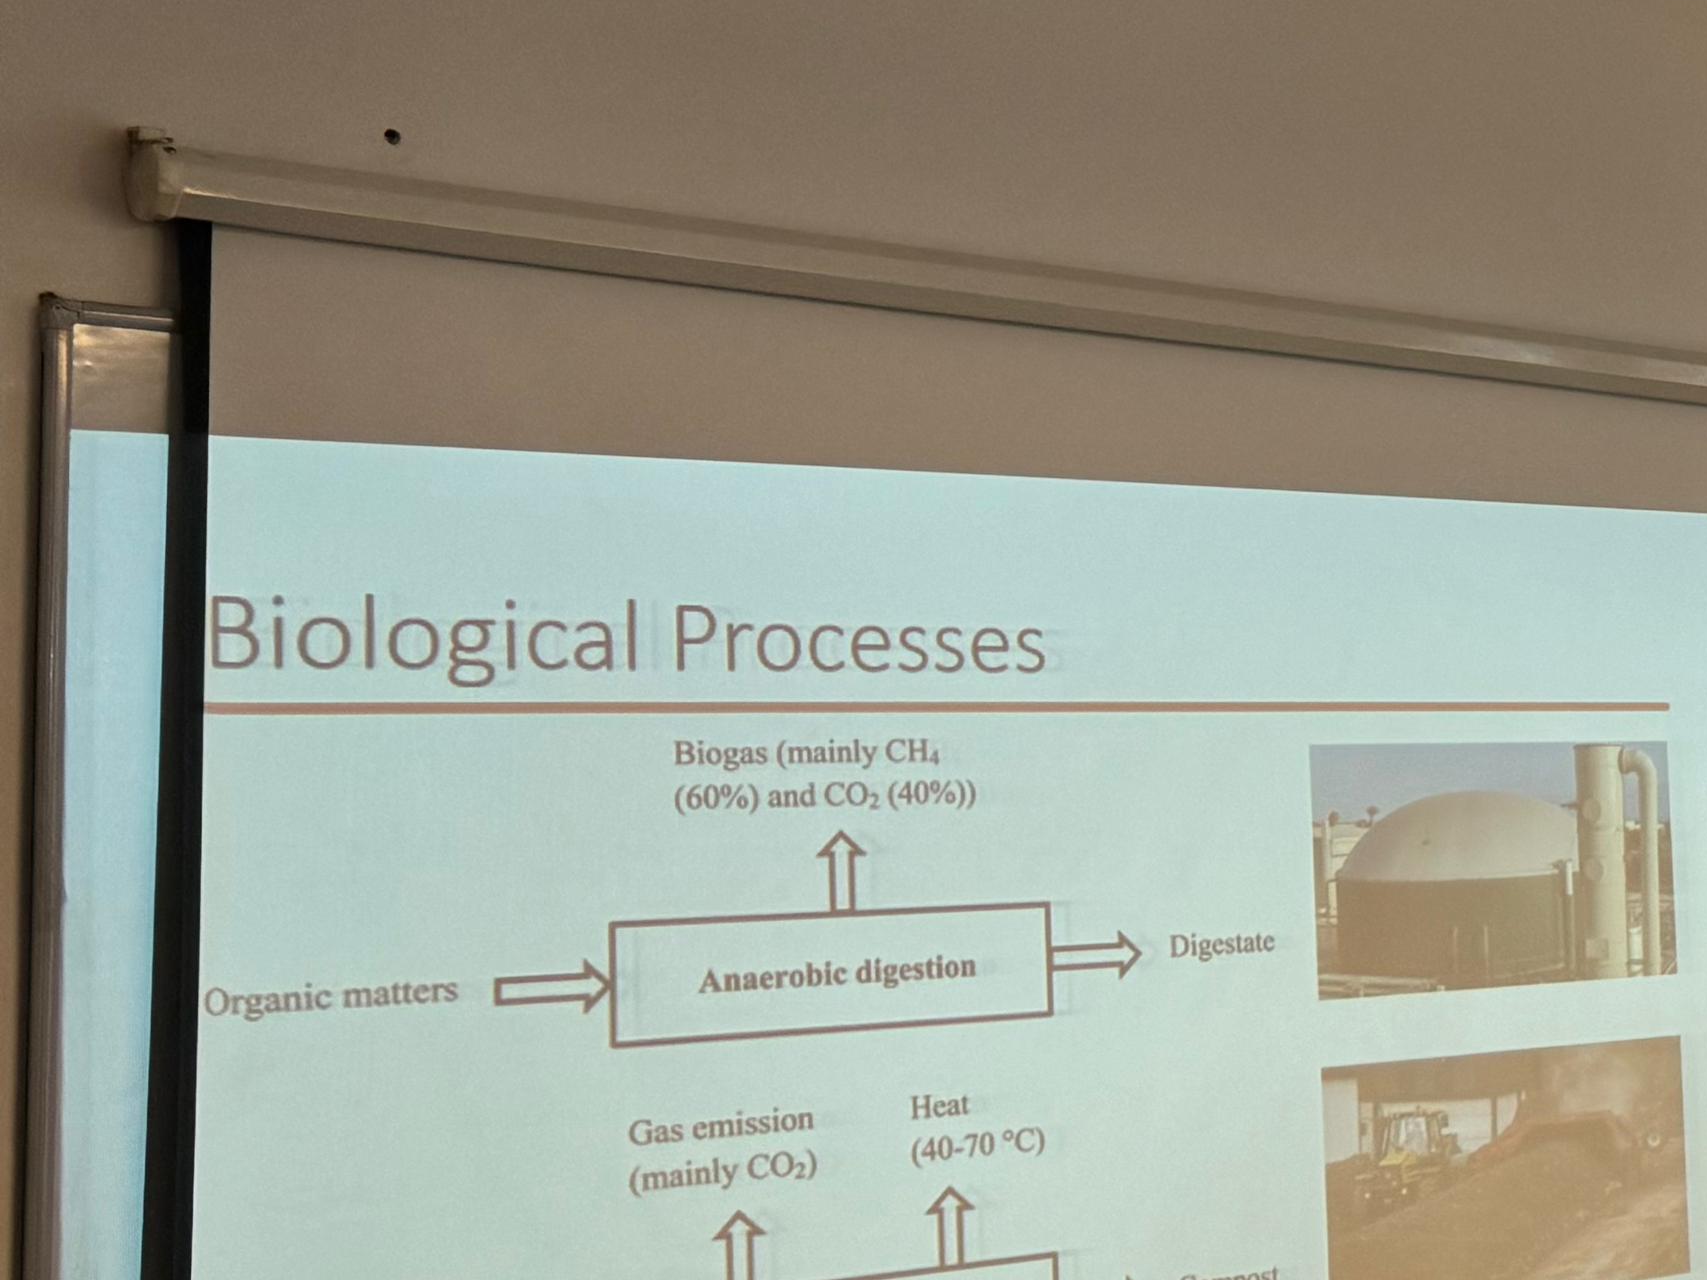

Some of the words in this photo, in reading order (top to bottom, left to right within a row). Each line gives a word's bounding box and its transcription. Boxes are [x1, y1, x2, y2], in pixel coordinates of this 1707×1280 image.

[210, 593, 637, 688] Biological
[675, 604, 1046, 674] Processes
[674, 739, 769, 773] Biogas
[776, 738, 879, 770] (mainly
[674, 783, 761, 816] (60%)
[767, 781, 817, 809] and
[887, 779, 977, 812] (40%))
[1169, 932, 1276, 963] Digestate
[698, 960, 848, 994] Anaerobic
[855, 954, 977, 988] digestion
[204, 982, 333, 1023] Organic
[342, 981, 460, 1009] matters
[628, 1119, 684, 1147] Gas
[692, 1106, 815, 1141] emission
[911, 1094, 970, 1121] Heat
[911, 1131, 996, 1169] (40-70
[628, 1157, 740, 1199] (mainly
